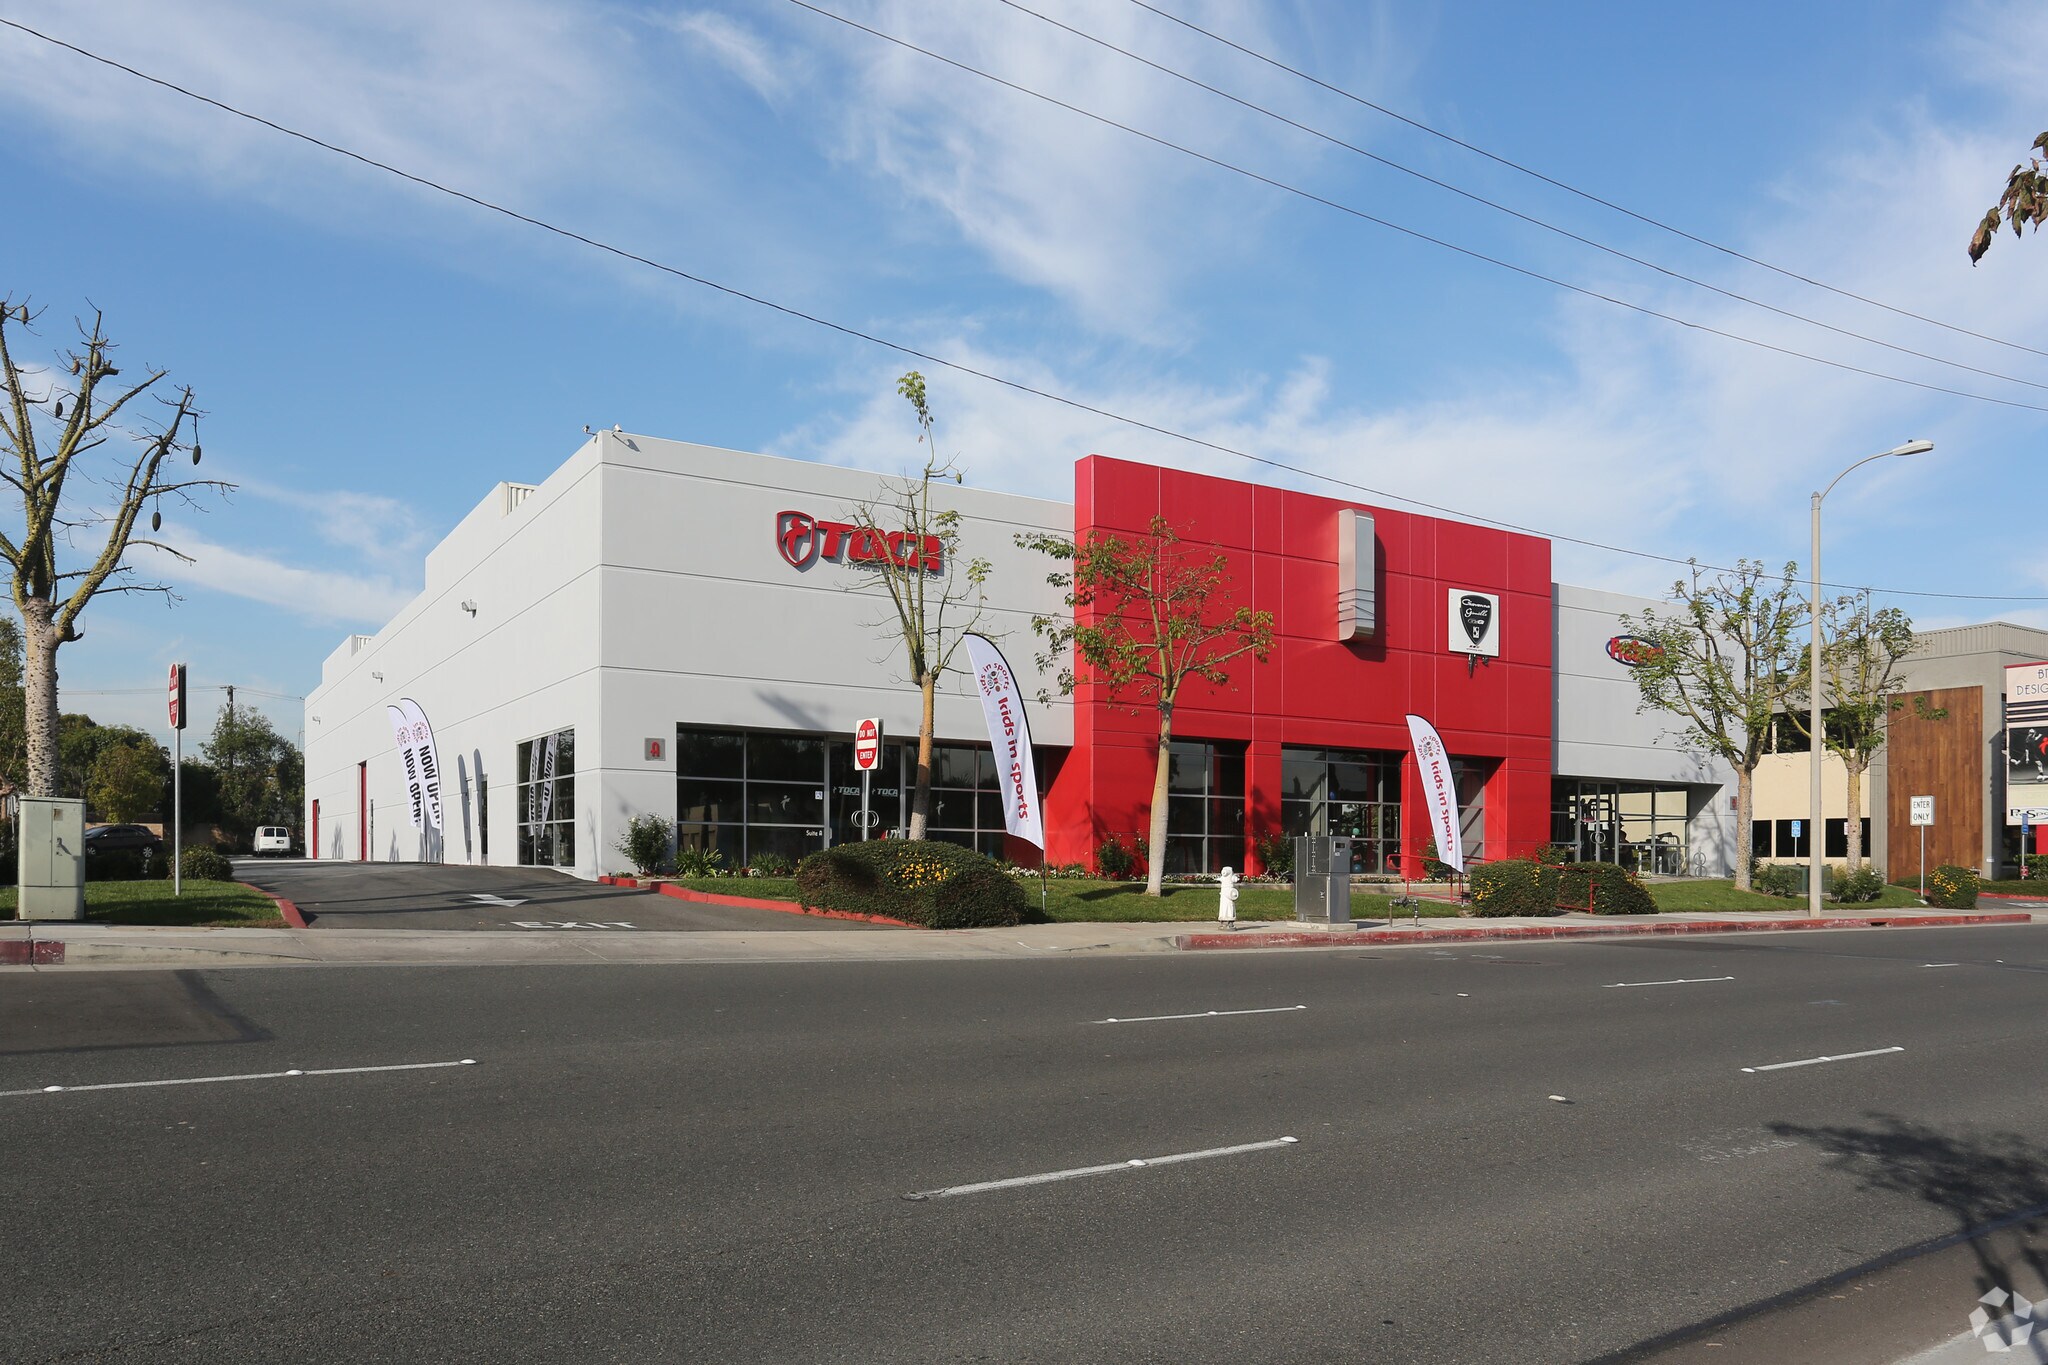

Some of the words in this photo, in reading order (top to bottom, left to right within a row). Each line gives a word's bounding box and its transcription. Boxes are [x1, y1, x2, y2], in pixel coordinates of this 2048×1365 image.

[816, 520, 940, 571] TOCA
[998, 697, 1014, 736] kids
[403, 748, 417, 781] NOW
[419, 745, 437, 780] NOW
[651, 741, 660, 758] A
[1008, 738, 1018, 759] in
[1010, 762, 1029, 819] sports
[1430, 760, 1444, 790] kids
[1438, 791, 1447, 806] in
[1913, 800, 1930, 809] ENTER
[1913, 813, 1930, 821] ONLY
[510, 921, 638, 929] EXIT
